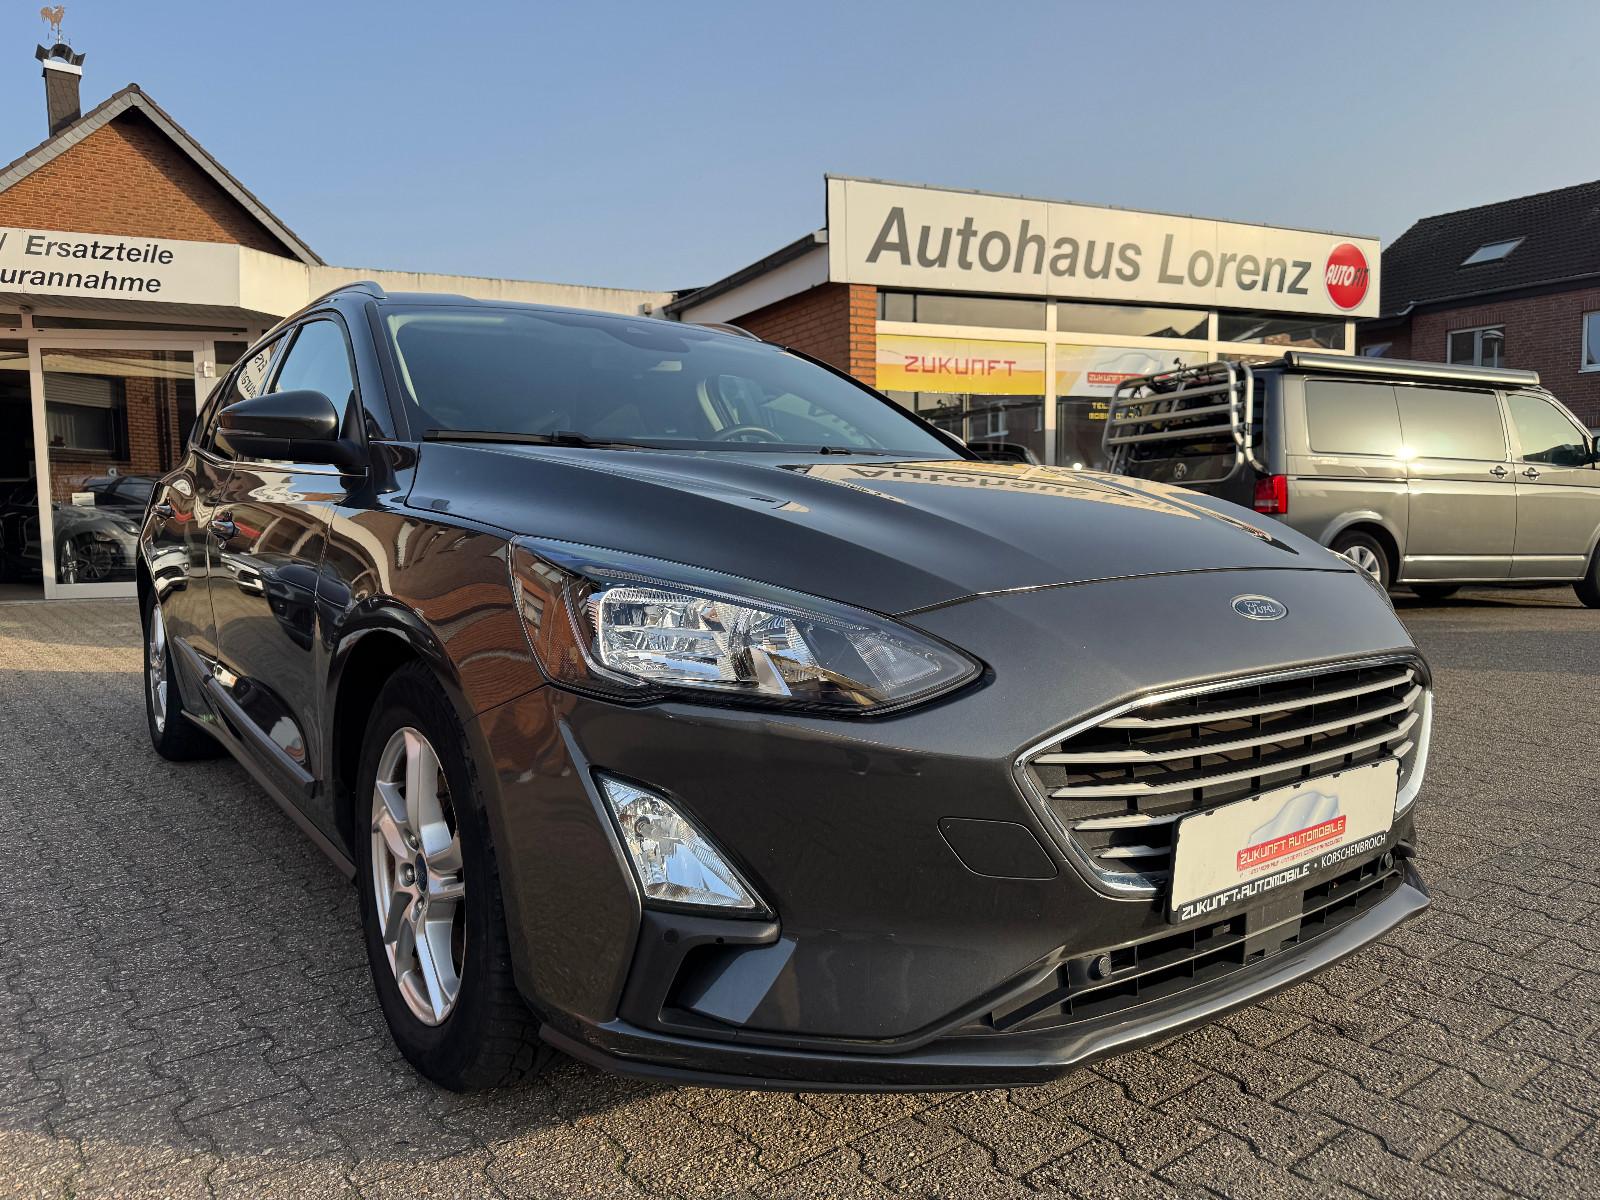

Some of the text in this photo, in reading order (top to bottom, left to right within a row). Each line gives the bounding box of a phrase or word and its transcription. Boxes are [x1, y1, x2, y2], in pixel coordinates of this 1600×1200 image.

[24, 235, 174, 265] Ersatzteile
[866, 206, 1312, 296] Autohaus Lorenz
[1, 268, 161, 293] urannahme
[1326, 263, 1370, 289] AUTOFIT
[904, 355, 1017, 377] ZUKUNFT
[1244, 600, 1276, 615] Ford
[1239, 836, 1286, 865] ZUKUNFT
[1288, 818, 1344, 849] AUTOMOBILE
[1321, 832, 1386, 868] KORSCHENBROICH
